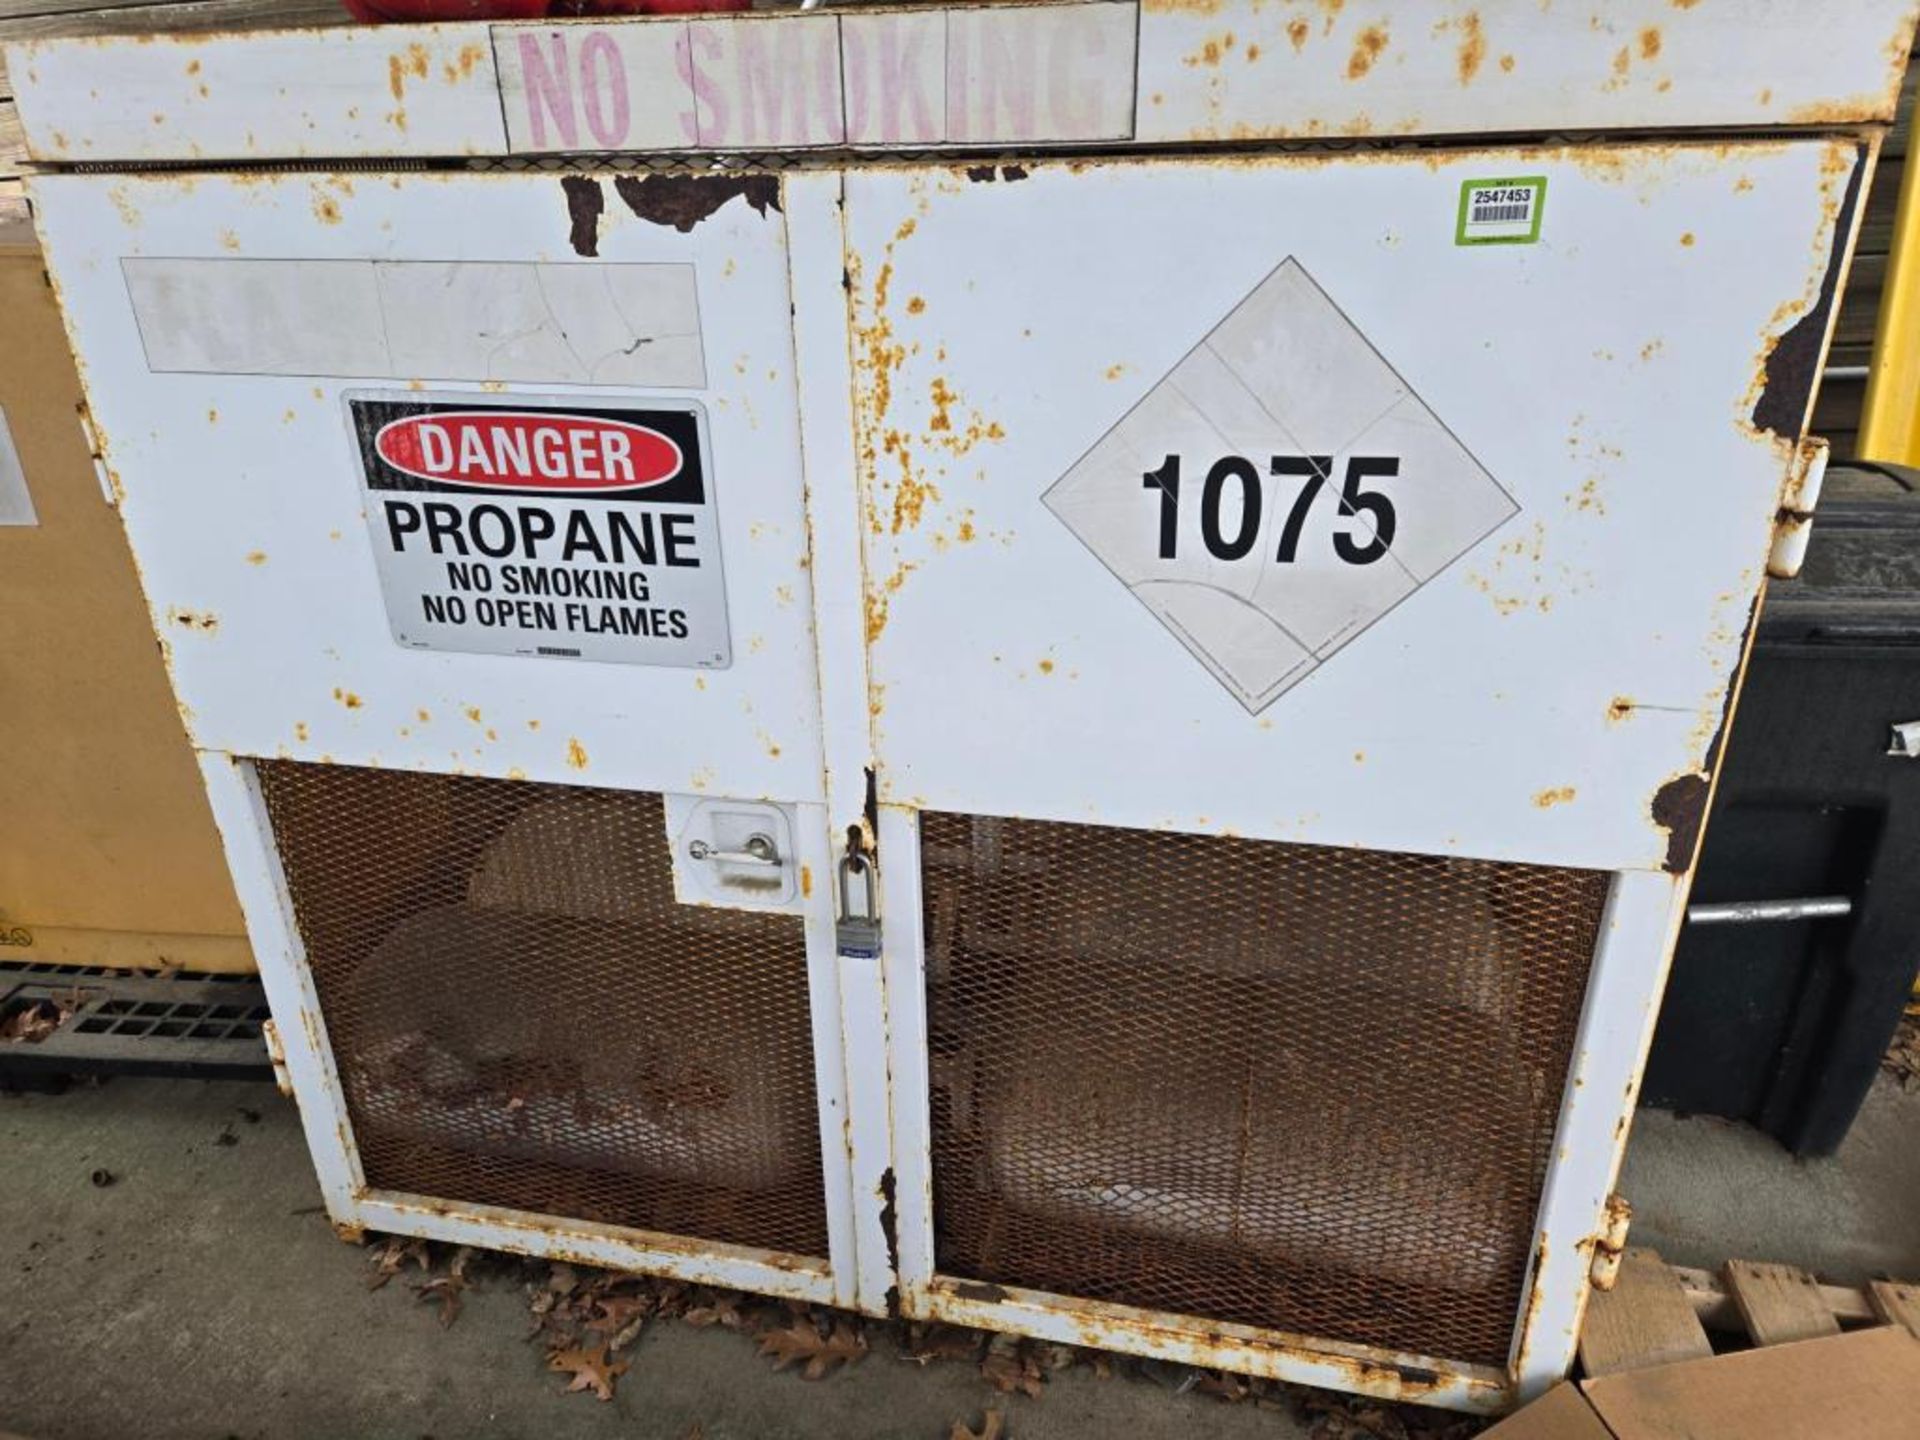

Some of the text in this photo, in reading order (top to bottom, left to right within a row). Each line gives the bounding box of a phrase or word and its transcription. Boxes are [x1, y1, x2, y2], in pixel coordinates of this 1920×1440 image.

[517, 14, 1108, 149] NO SMOKING
[1475, 189, 1531, 204] 2547453
[417, 421, 636, 482] DANGER
[384, 499, 702, 568] PROPANE
[1142, 452, 1400, 566] 1075
[447, 562, 650, 602] NO SMOKING
[421, 593, 688, 639] NO OPEN FLAMES
